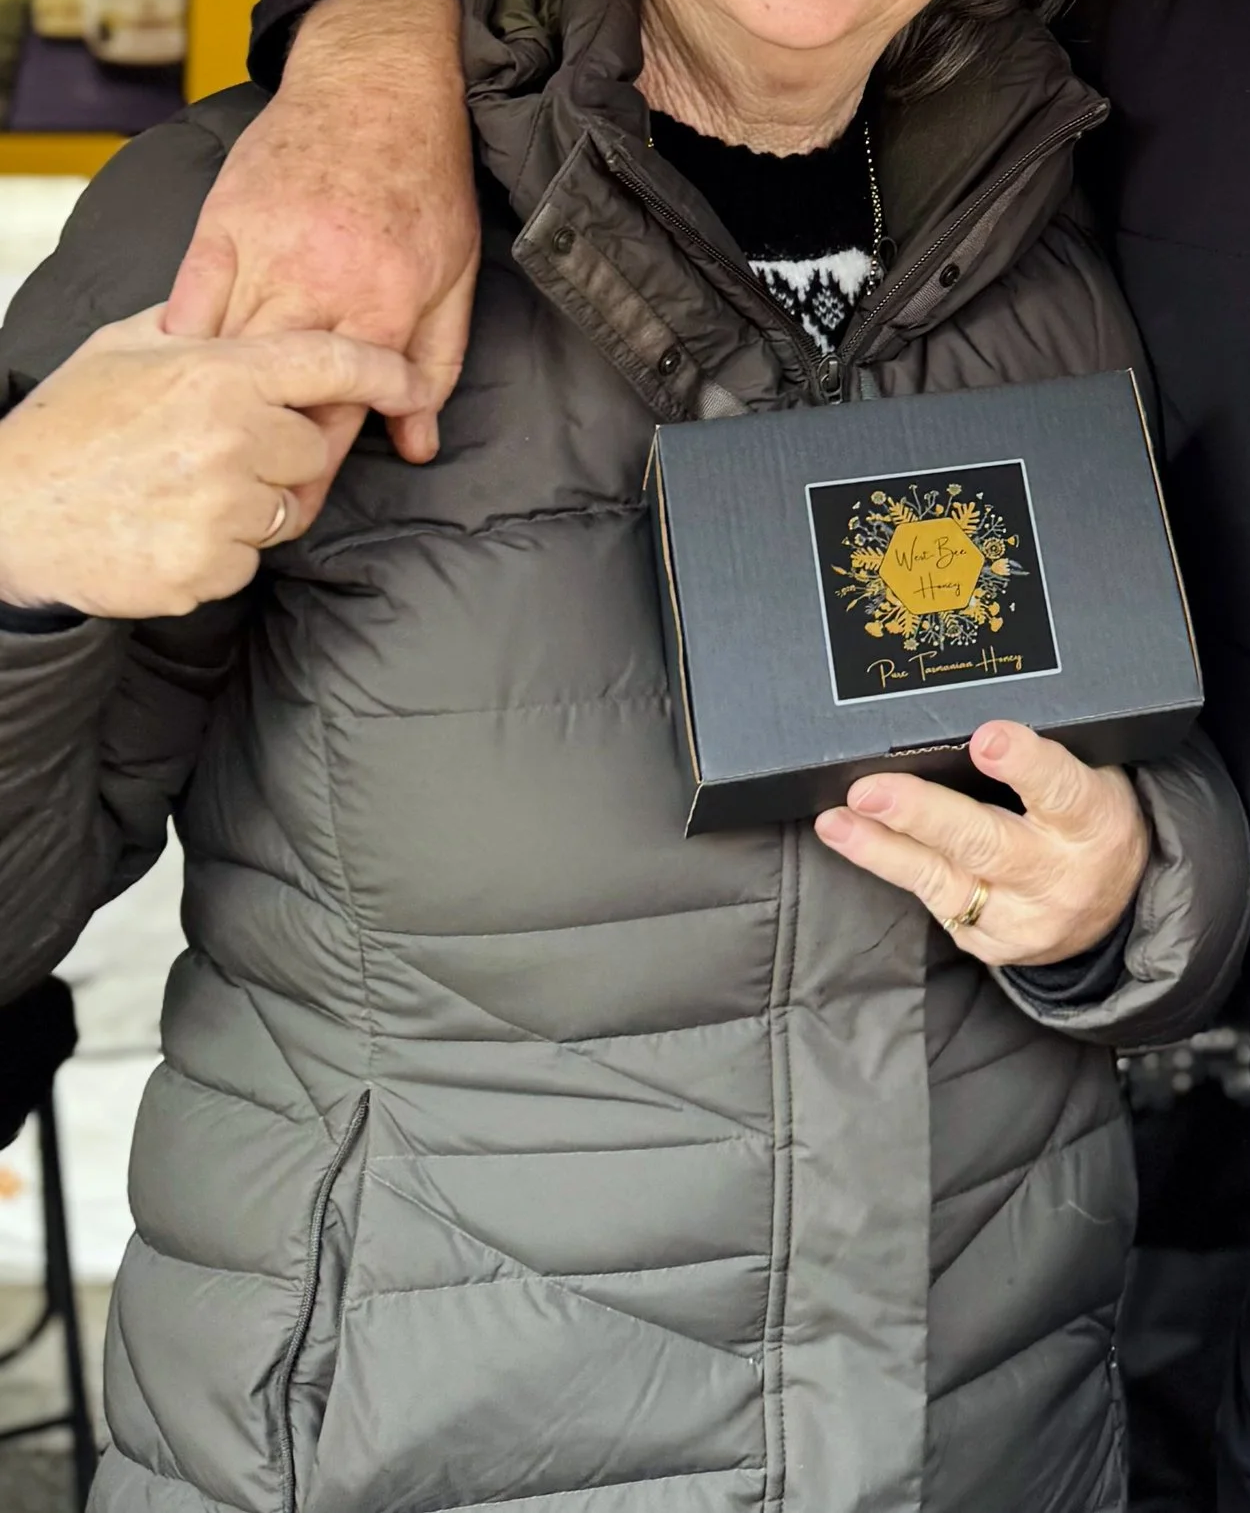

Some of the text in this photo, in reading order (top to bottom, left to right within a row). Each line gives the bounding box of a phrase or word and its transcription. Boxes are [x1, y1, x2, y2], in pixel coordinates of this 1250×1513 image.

[913, 572, 961, 600] Honey
[866, 645, 1023, 689] Pure Tasmanian Honey
